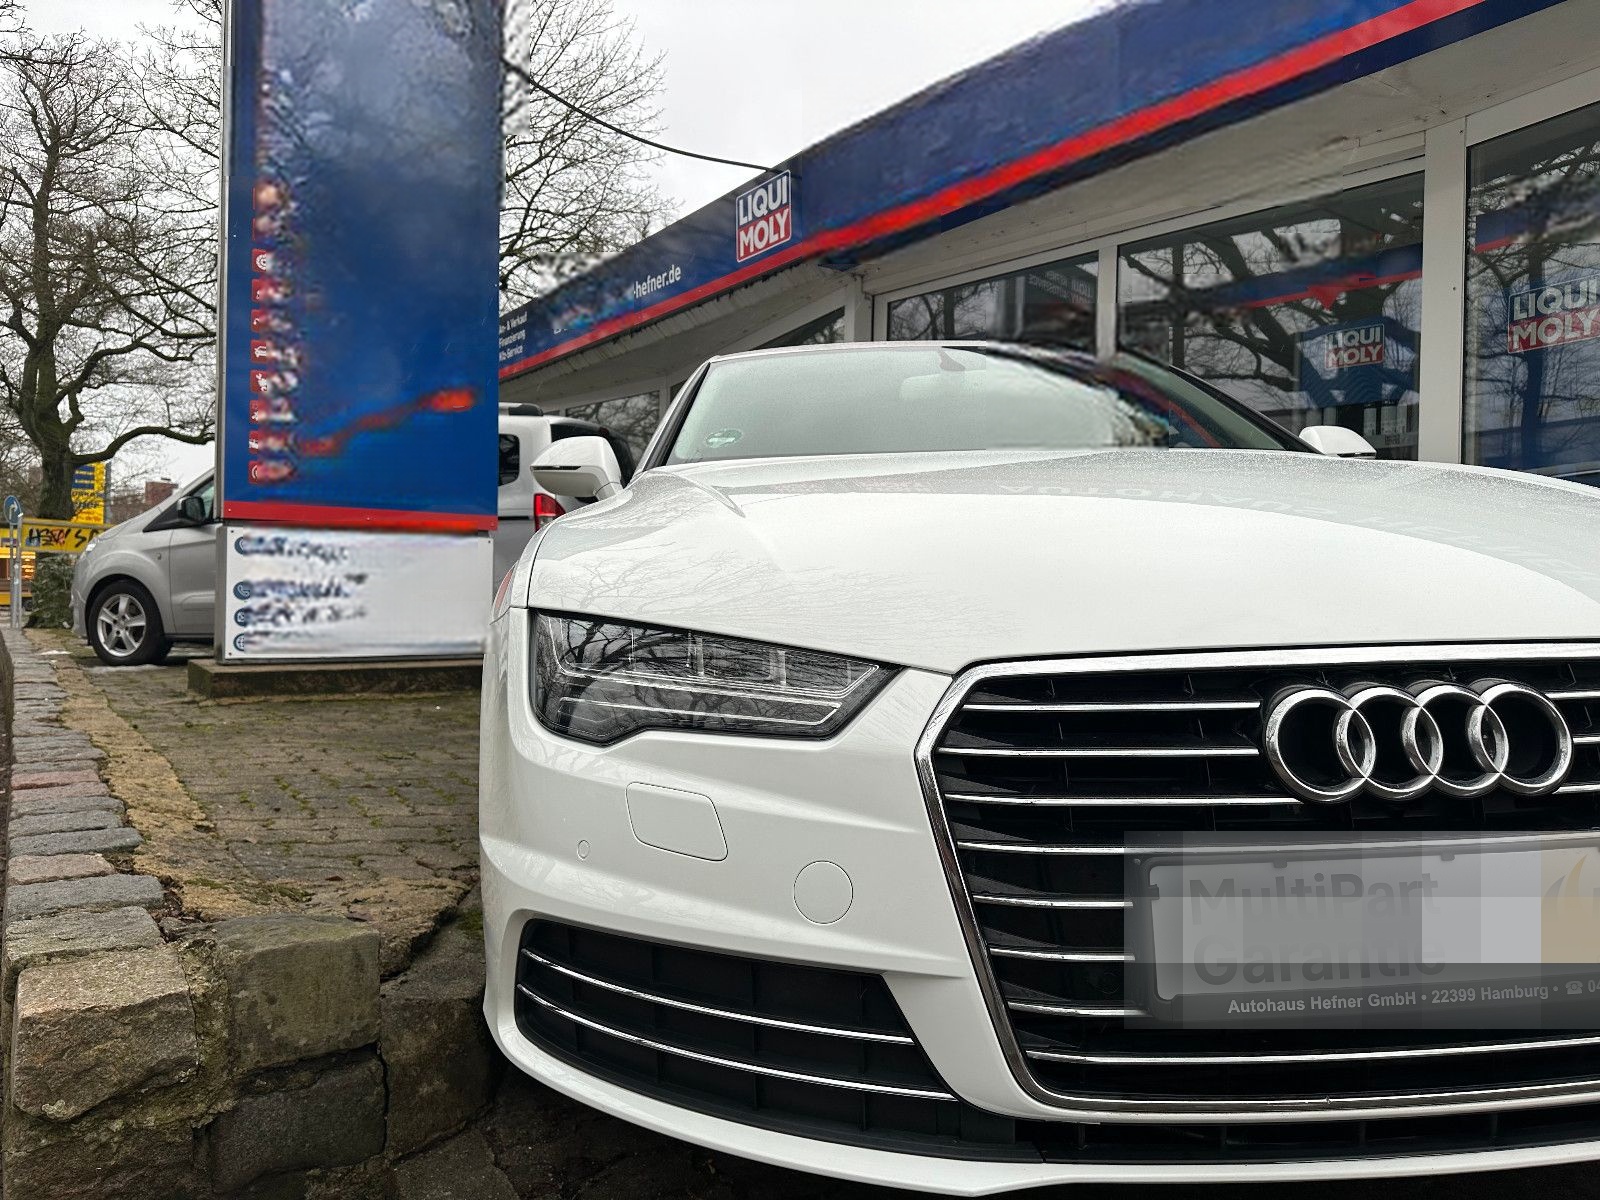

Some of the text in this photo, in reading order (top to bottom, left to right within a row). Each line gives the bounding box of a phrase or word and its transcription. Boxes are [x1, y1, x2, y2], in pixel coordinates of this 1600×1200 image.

[739, 175, 788, 226] LIQUI
[740, 208, 789, 257] MOLY
[1513, 278, 1597, 321] LIQUI
[1328, 327, 1381, 350] LIQUI
[1513, 308, 1600, 349] MOLY
[1328, 345, 1382, 368] MOLY
[1189, 872, 1442, 926] MultiPart
[1194, 934, 1446, 986] Garantie
[1227, 998, 1306, 1014] Autohaus
[1310, 995, 1363, 1010] Hefner
[1368, 991, 1416, 1007] GmbH
[1431, 988, 1476, 1004] 22399
[1481, 984, 1549, 1000] Hamburg
